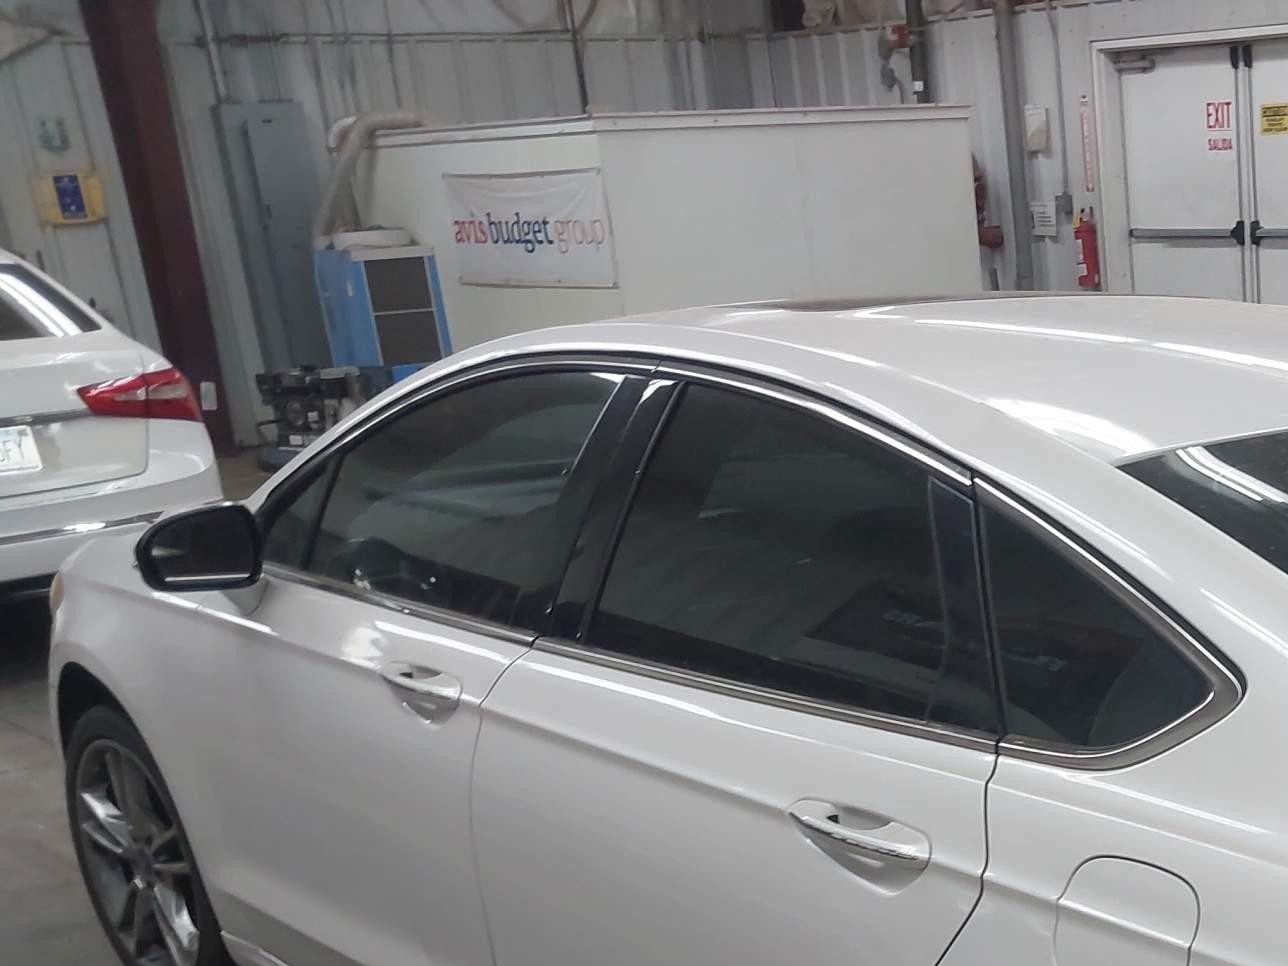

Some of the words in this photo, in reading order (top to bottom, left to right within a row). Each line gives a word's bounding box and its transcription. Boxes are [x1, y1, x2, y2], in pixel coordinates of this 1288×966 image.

[1206, 102, 1232, 128] EXIT
[1208, 138, 1232, 151] SALIDA
[555, 219, 605, 254] group
